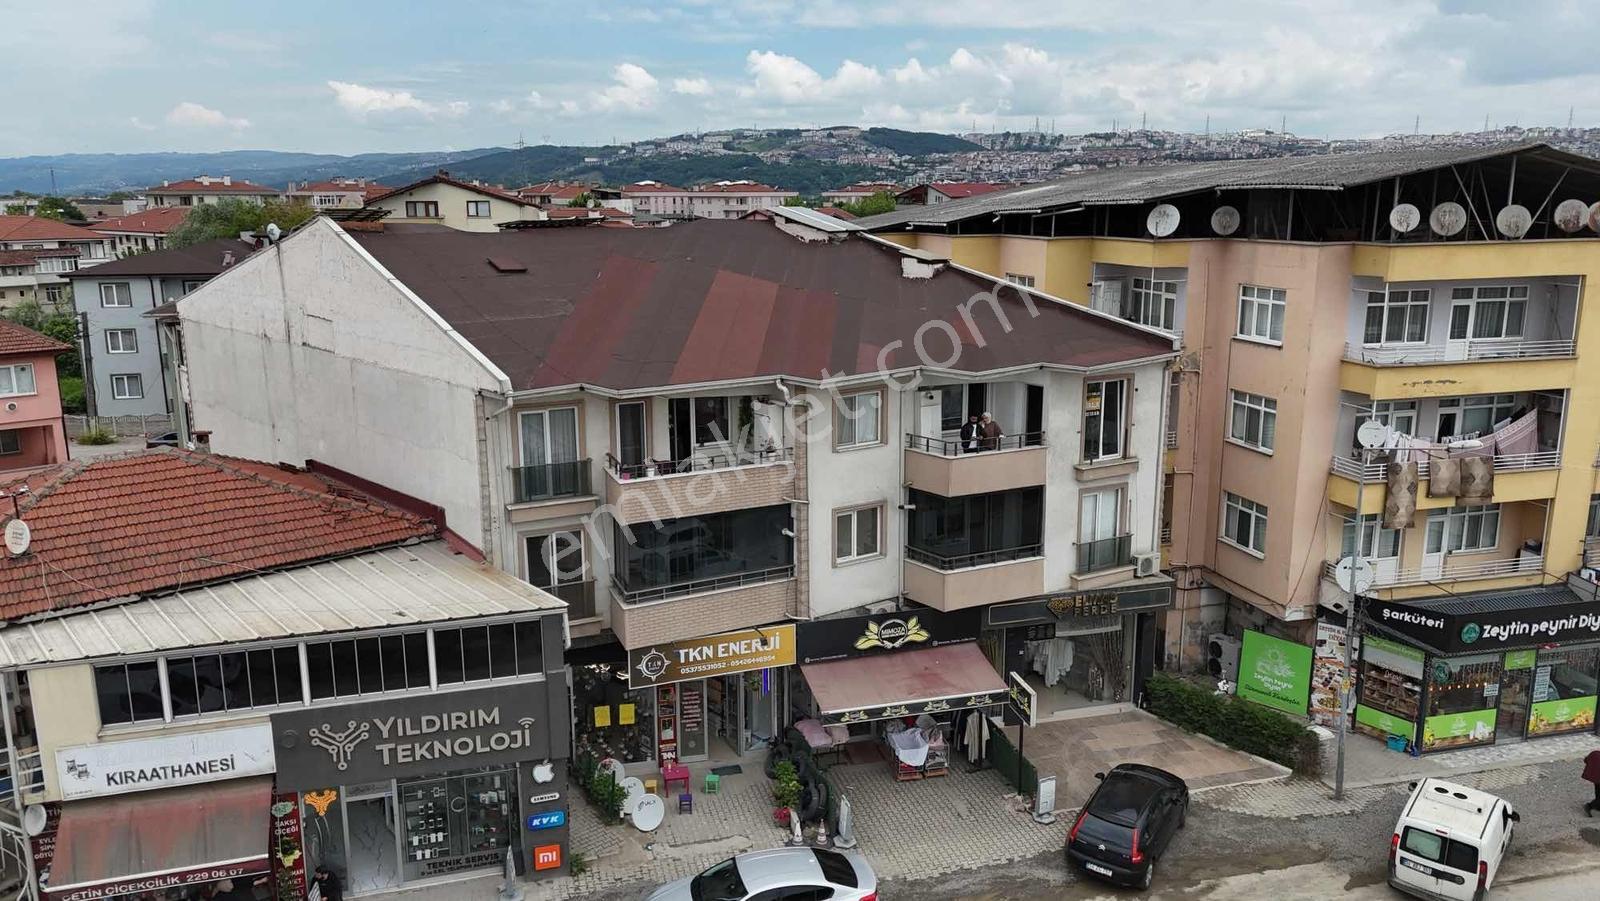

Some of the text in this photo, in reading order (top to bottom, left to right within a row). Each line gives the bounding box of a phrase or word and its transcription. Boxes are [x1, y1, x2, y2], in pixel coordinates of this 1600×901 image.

[1382, 608, 1444, 629] Şarküteri
[1481, 612, 1600, 642] Zeytin peynir Diy
[678, 632, 780, 664] TKN ENERJİ
[373, 706, 500, 739] YILDIRIM
[375, 723, 531, 766] TEKNOLOJİ
[106, 754, 236, 787] KIRAATHANESİ
[532, 815, 560, 826] KVK
[186, 871, 209, 882] 229
